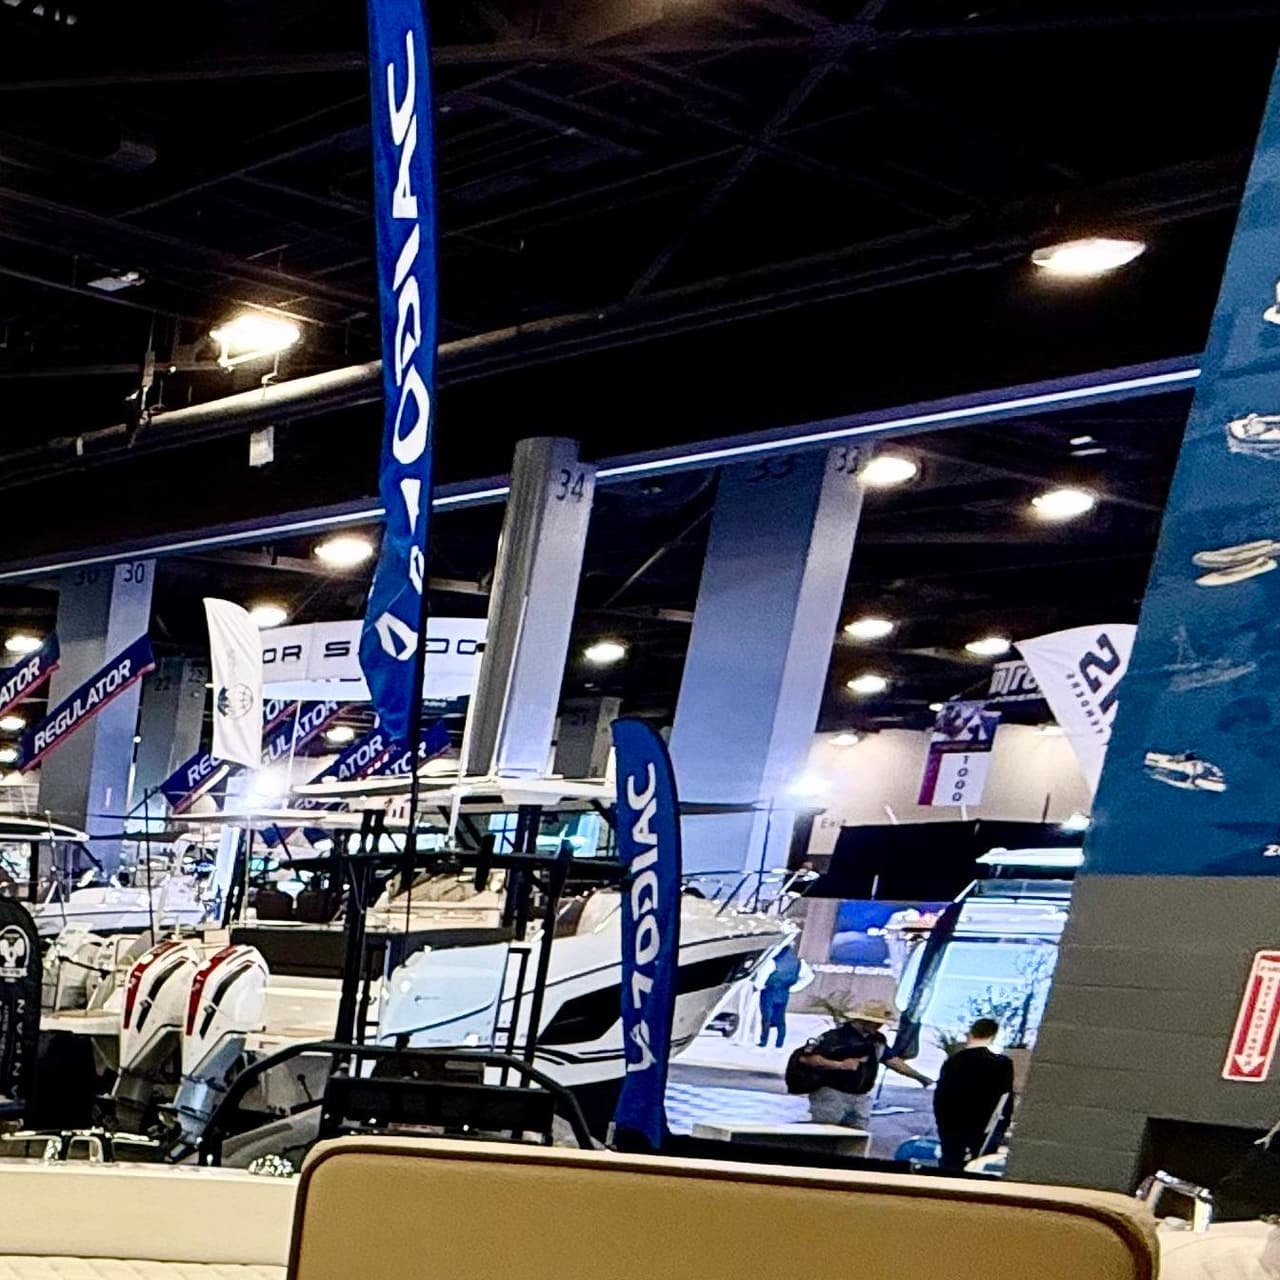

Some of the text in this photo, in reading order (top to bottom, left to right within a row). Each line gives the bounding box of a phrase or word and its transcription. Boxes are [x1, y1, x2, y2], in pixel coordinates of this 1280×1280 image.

[555, 468, 585, 503] 34
[123, 561, 145, 584] 30
[33, 657, 132, 755] REGULATOR
